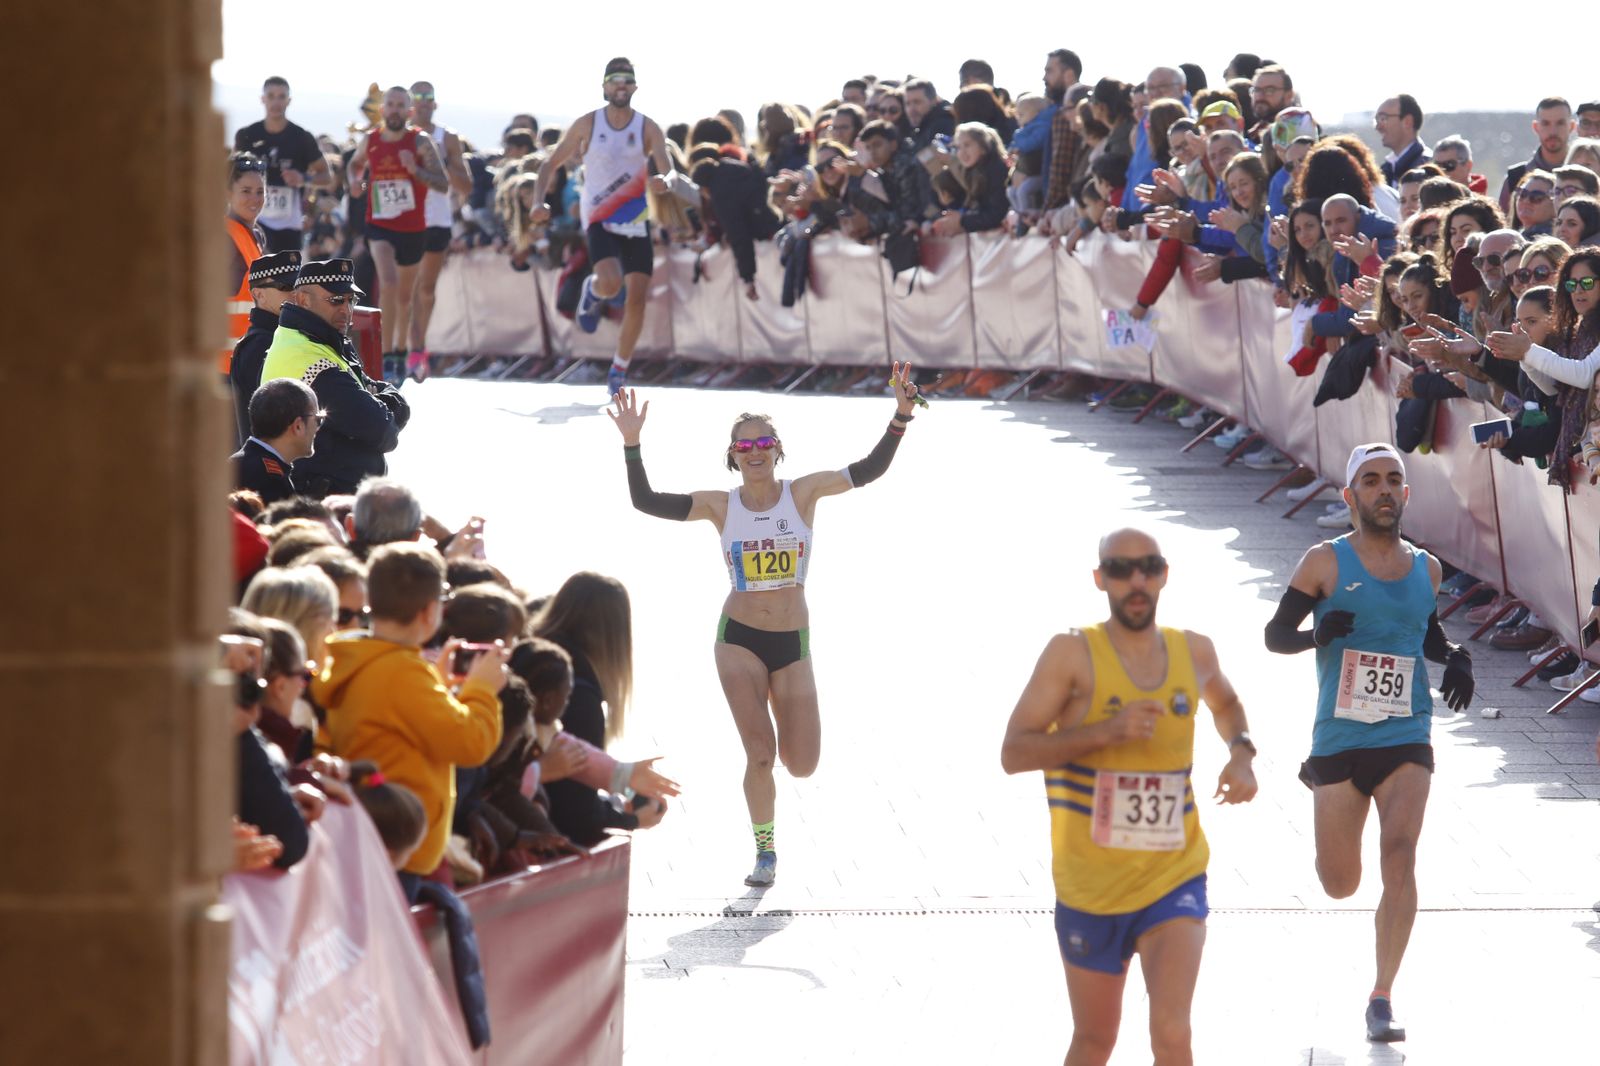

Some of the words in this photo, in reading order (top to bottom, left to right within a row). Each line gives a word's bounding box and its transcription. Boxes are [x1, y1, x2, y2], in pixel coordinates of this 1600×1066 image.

[752, 550, 790, 574] 120
[1364, 669, 1404, 698] 359
[1353, 694, 1369, 702] DAVID
[1126, 794, 1177, 825] 337
